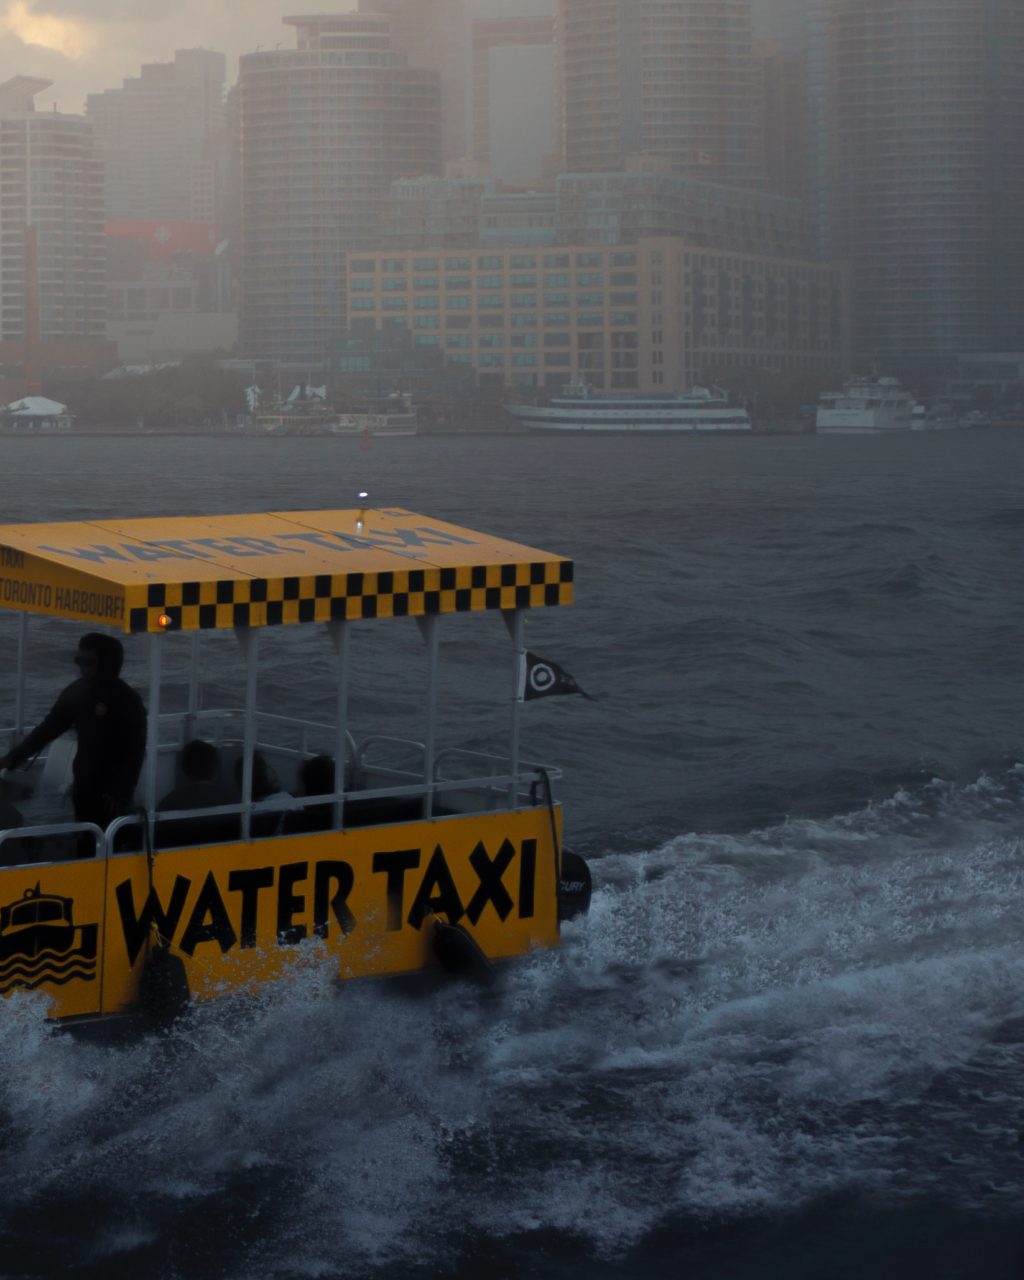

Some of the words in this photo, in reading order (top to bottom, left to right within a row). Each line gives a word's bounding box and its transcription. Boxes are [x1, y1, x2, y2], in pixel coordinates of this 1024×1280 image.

[1, 547, 25, 568] TAXI
[36, 536, 304, 564] WATER
[272, 526, 479, 553] TAXI
[116, 860, 356, 968] WATER
[373, 838, 537, 931] TAXI
